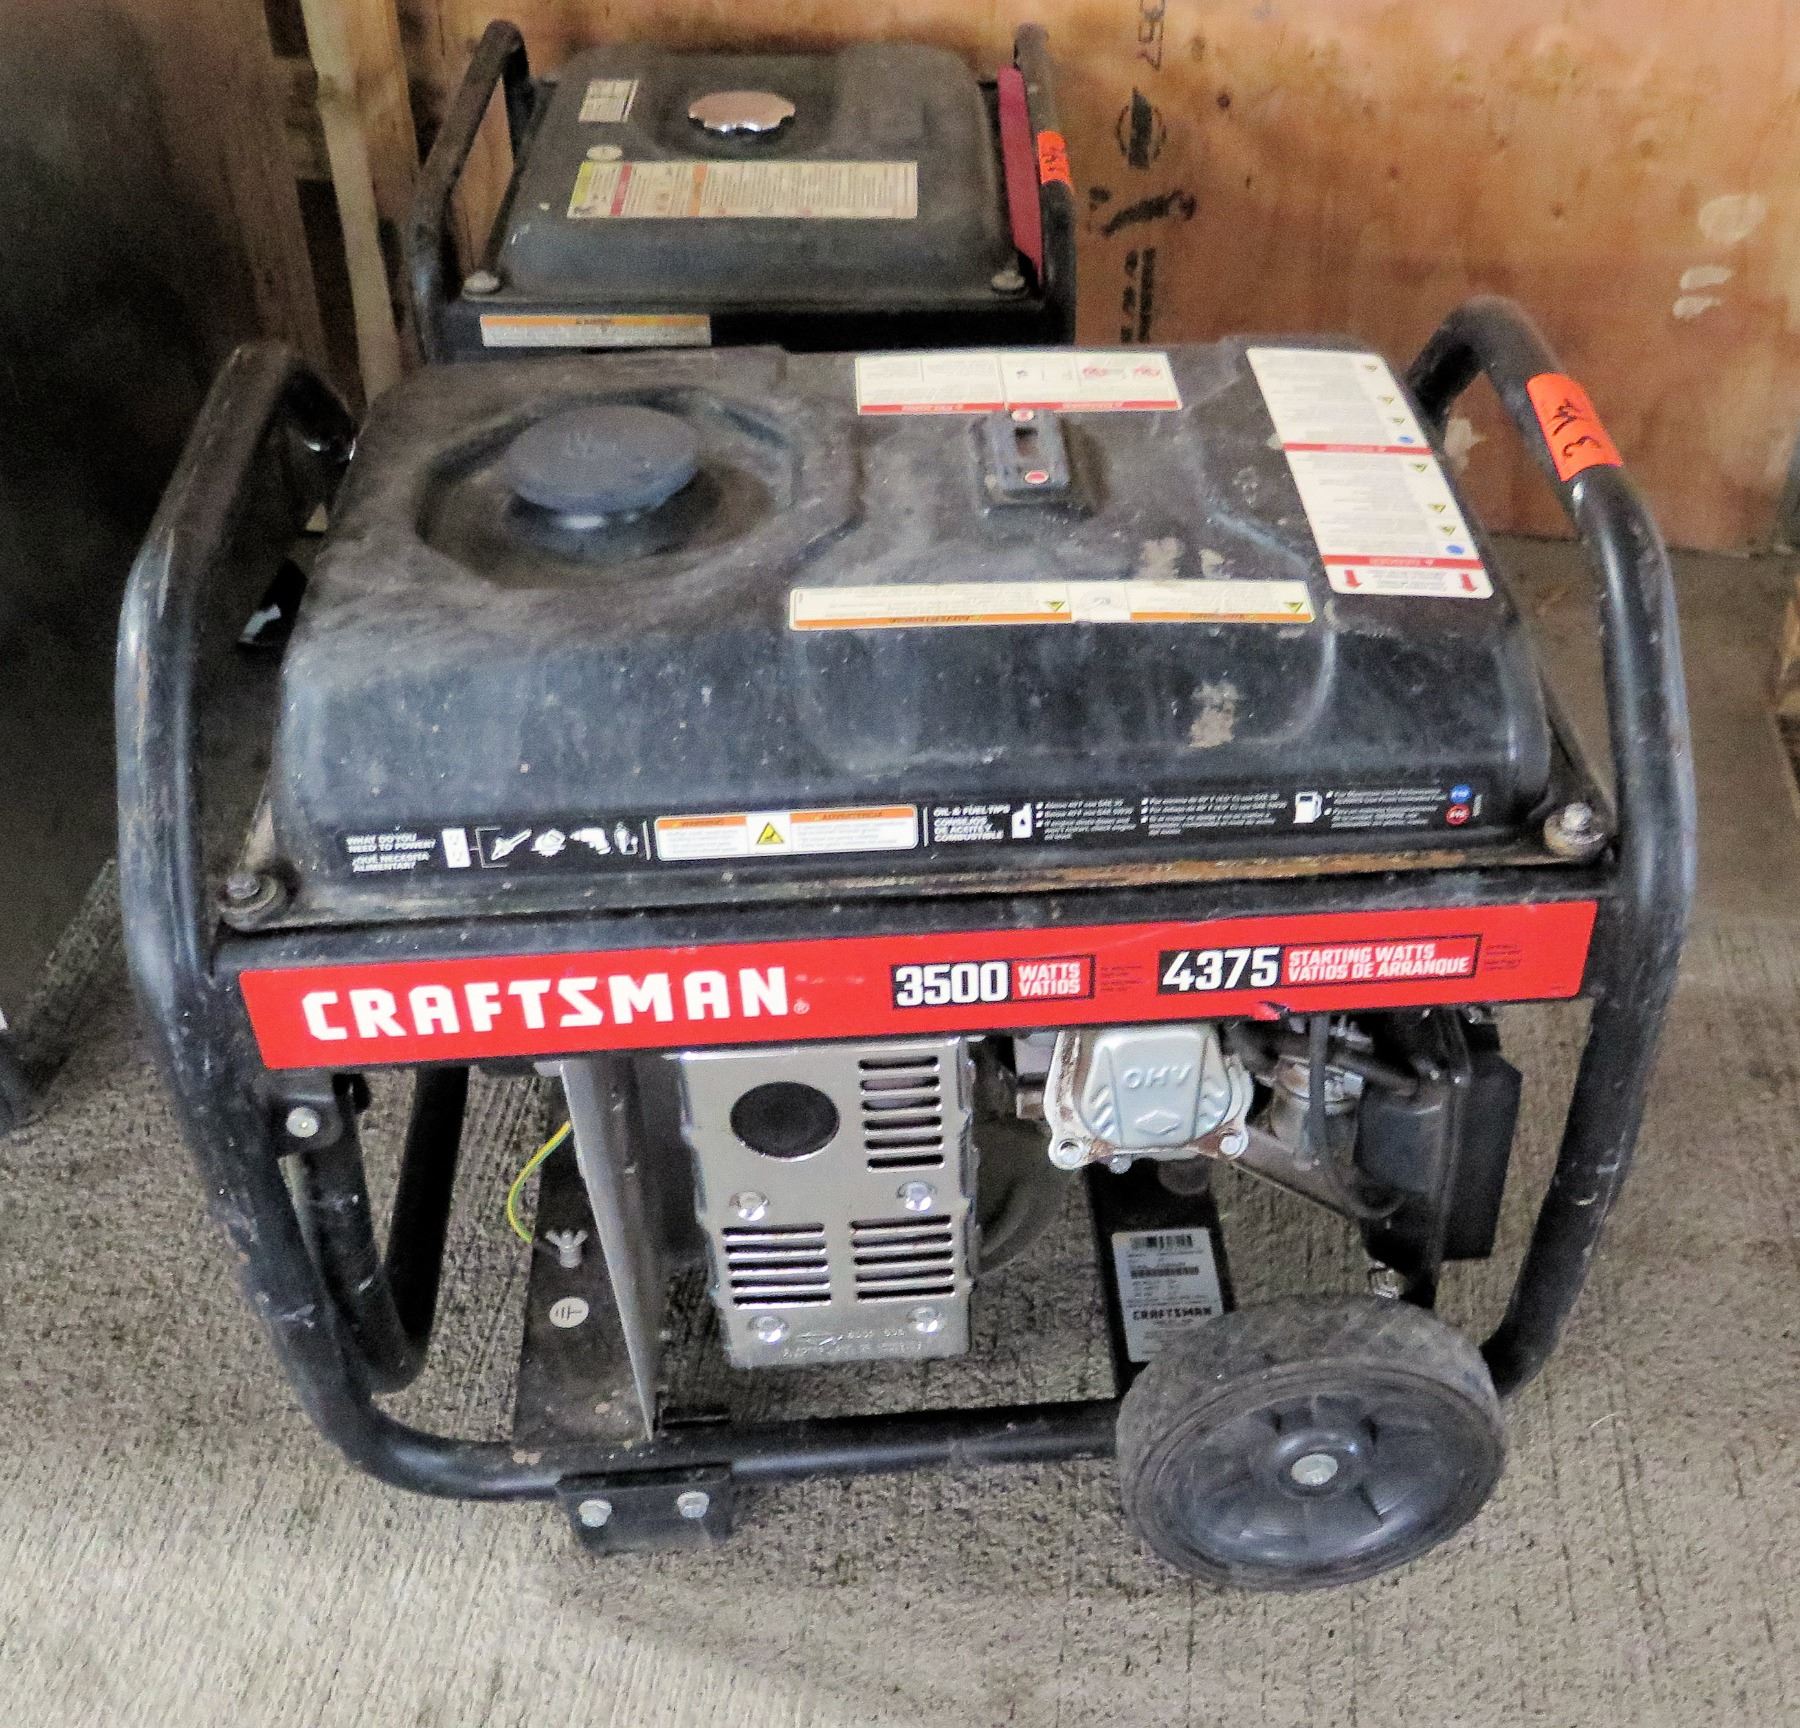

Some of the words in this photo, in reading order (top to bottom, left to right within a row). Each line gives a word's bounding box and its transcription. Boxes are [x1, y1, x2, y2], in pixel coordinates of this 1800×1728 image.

[1288, 946, 1371, 968] STARTING
[1375, 943, 1436, 962] WATTS
[1017, 961, 1081, 981] WATTS
[1162, 946, 1281, 992] 4375
[1288, 962, 1349, 982] VATIOS
[1351, 962, 1374, 979] DE
[1376, 956, 1471, 977] ARRANQUE
[895, 960, 1009, 1007] 3500
[1018, 978, 1081, 997] VATIOS
[301, 965, 788, 1041] CRAFTSMAN
[1122, 1063, 1193, 1089] OHV
[1133, 1306, 1211, 1320] CRAFTSMAN
